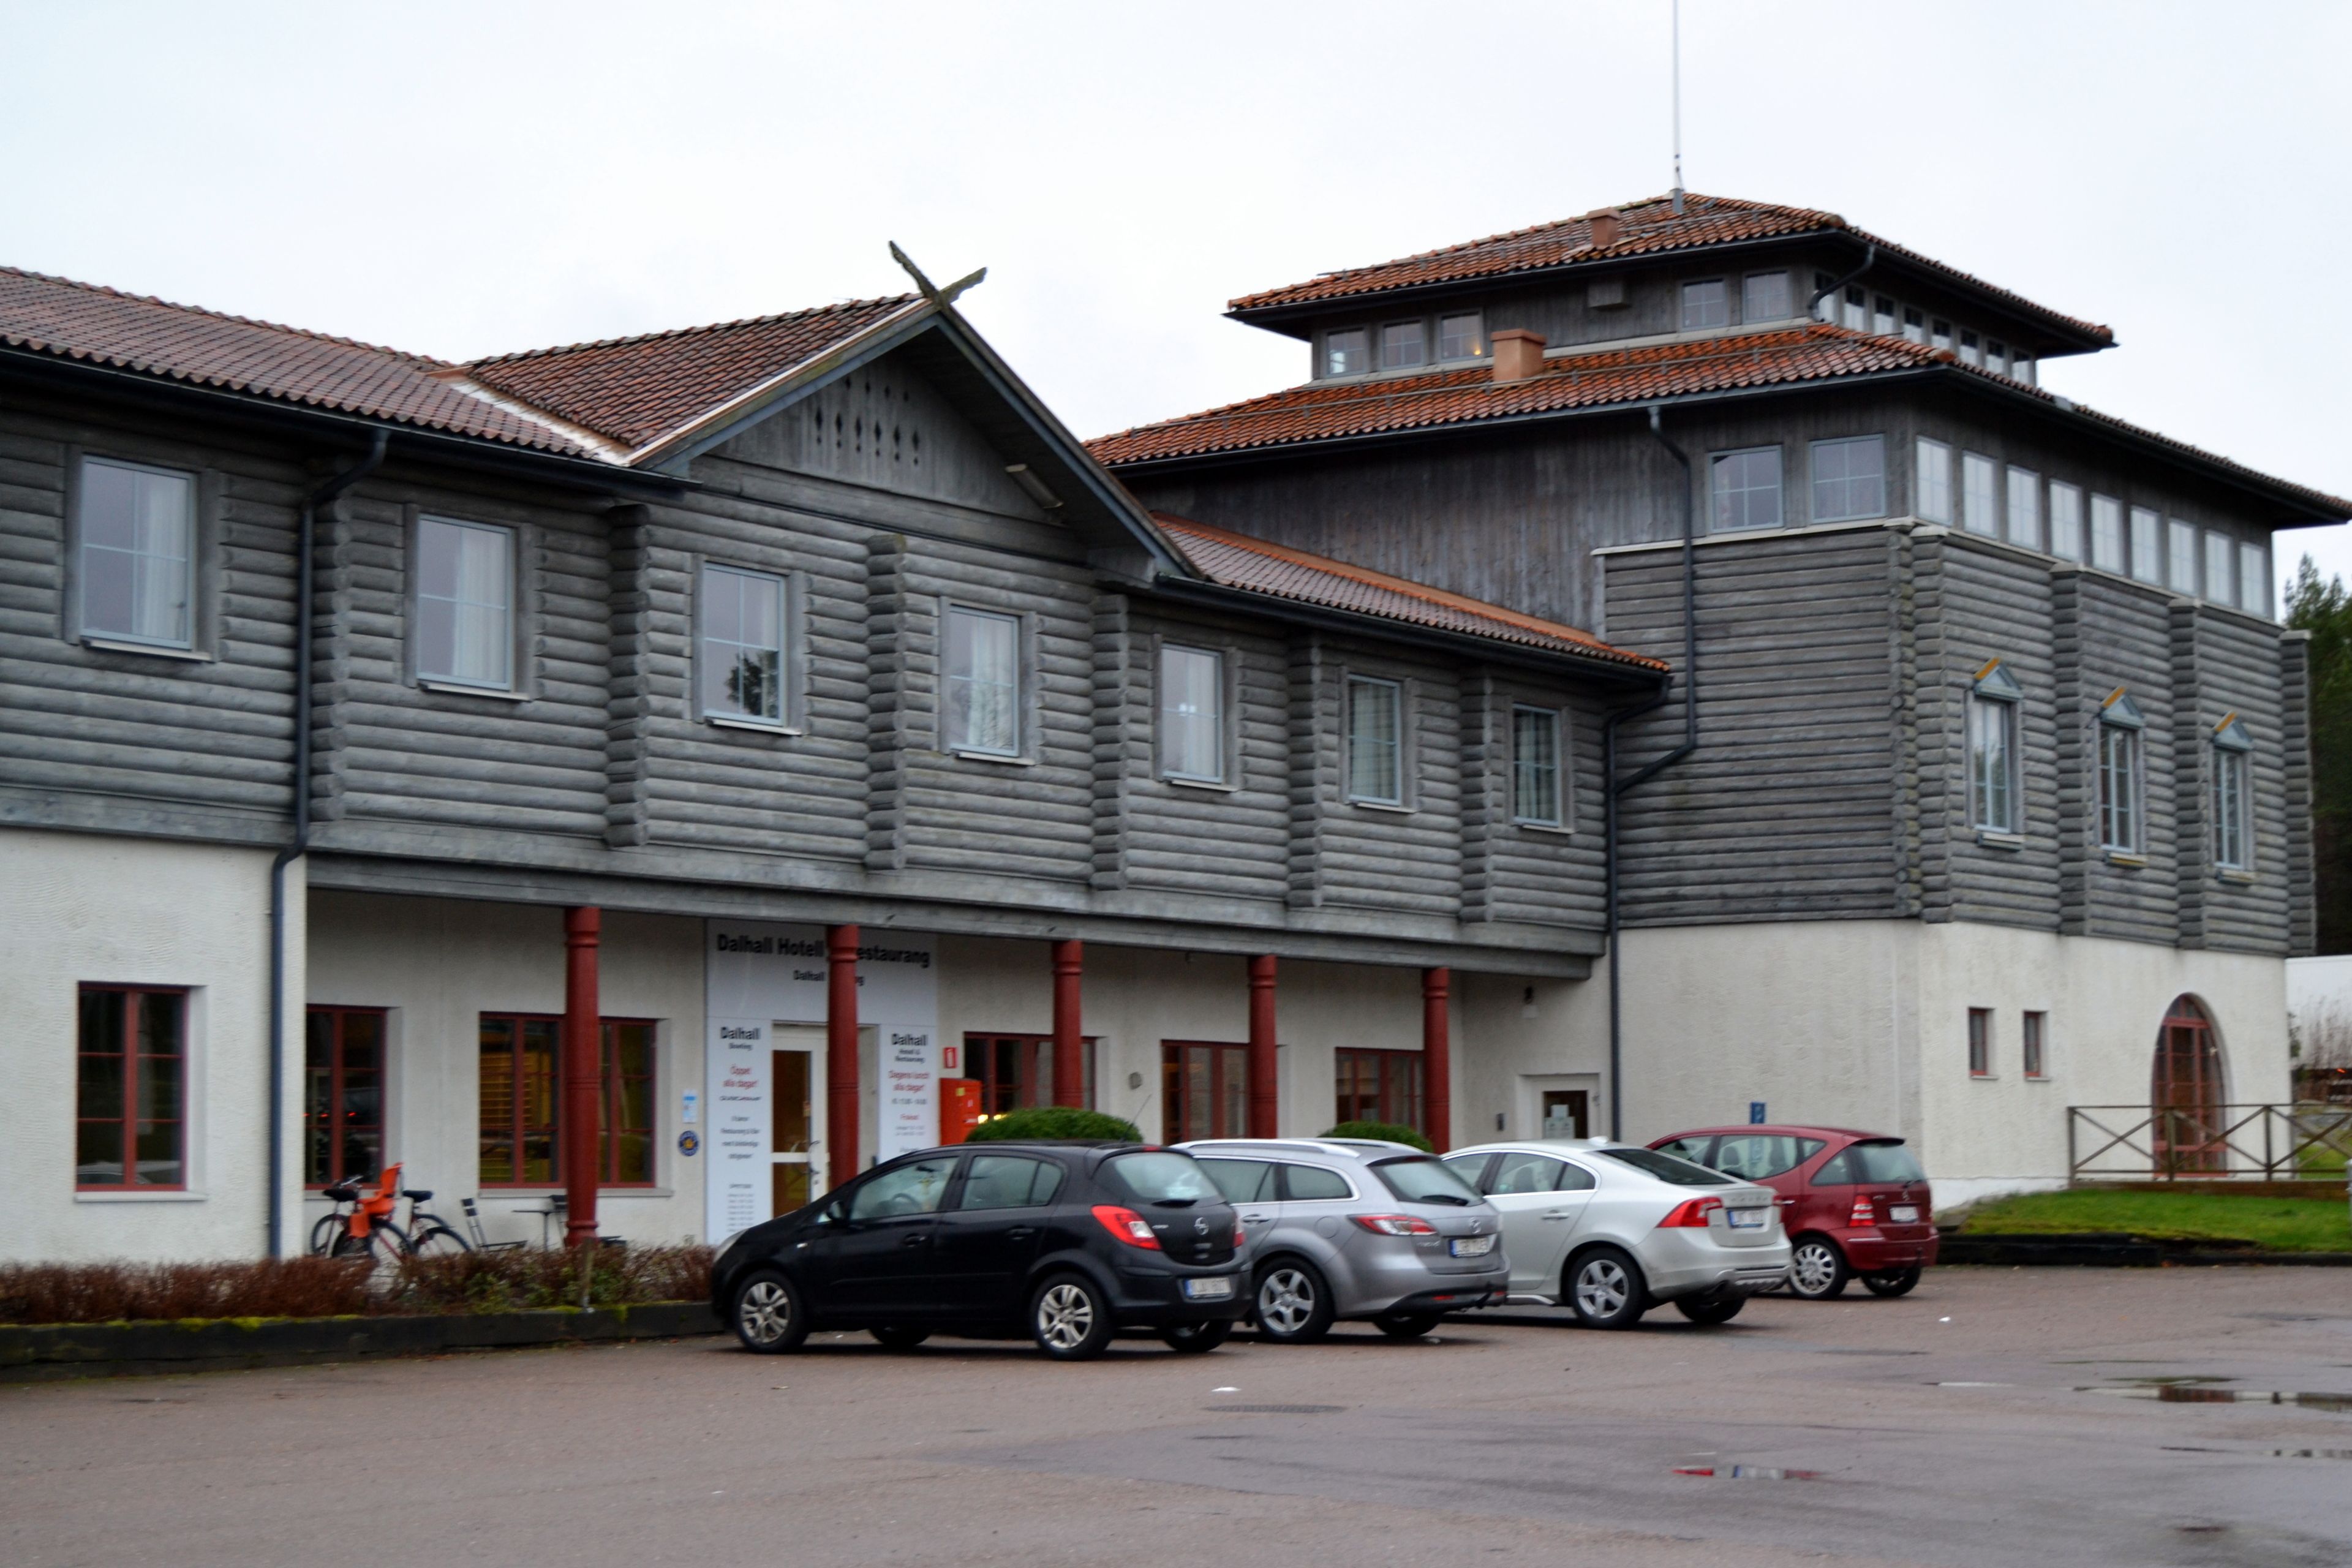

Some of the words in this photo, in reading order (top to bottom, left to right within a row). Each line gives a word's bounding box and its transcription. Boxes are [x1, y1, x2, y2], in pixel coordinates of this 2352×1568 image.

[717, 934, 773, 954] Dalhall
[777, 938, 824, 957] Hotell
[858, 945, 930, 968] estaurang
[793, 970, 824, 981] Dalhall
[720, 1027, 761, 1040] Dalhall
[891, 1033, 929, 1046] Dalhall
